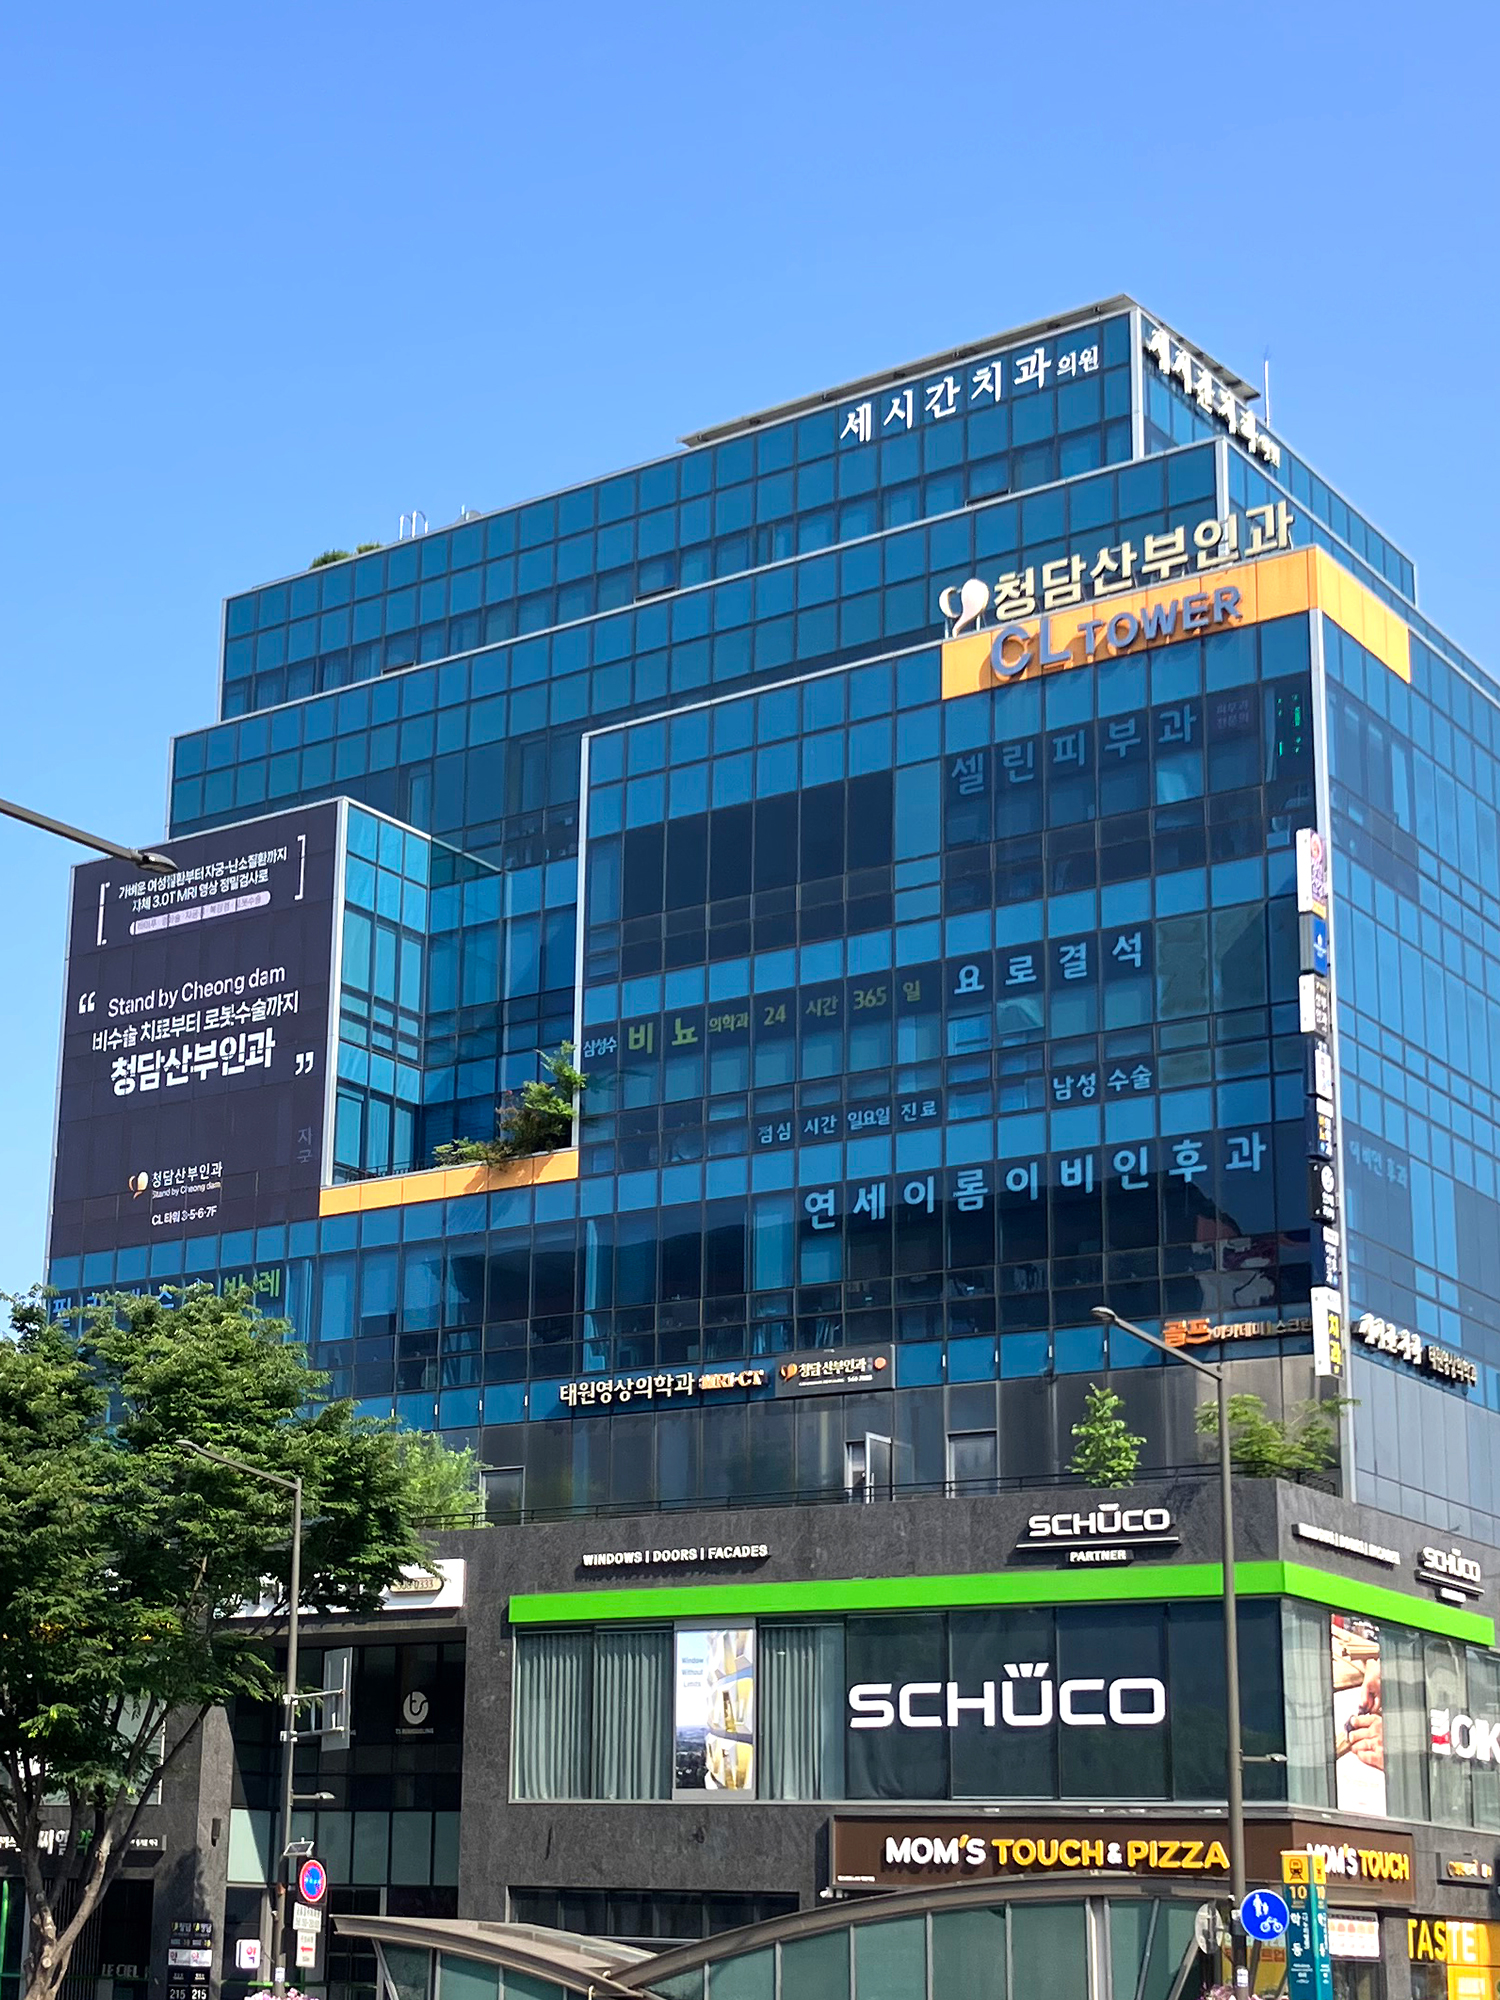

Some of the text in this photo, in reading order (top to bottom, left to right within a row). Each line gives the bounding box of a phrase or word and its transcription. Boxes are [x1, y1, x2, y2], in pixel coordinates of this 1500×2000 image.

[993, 500, 1294, 622] 청담산부인과
[990, 585, 1242, 677] CL TOWER
[177, 886, 197, 903] MRI
[199, 882, 219, 898] 영상
[953, 930, 1143, 996] 요로결석
[108, 966, 286, 1018] Stand by Cheong dam
[92, 990, 299, 1052] 비수술 치료부터 로봇수술까지
[110, 1027, 276, 1096] 청담산부인과
[1052, 1063, 1153, 1101] 남성 수술
[757, 1100, 938, 1145] 점심 시간 일요일 진료
[151, 1160, 223, 1188] 청담산부인과
[558, 1373, 694, 1407] 태원영상의학과
[1028, 1503, 1171, 1537] SCHÜCO
[583, 1544, 768, 1566] WINDOWS DOORS FACADES
[1069, 1549, 1127, 1563] PARTNER
[849, 1662, 1166, 1728] SCHÜCO
[885, 1834, 986, 1865] MOM'S
[991, 1838, 1104, 1867] TOUCH
[1127, 1841, 1230, 1869] PIZZA
[1358, 1849, 1409, 1880] TOUCH
[1289, 1885, 1307, 1900] 10
[1407, 1918, 1477, 1962] TASTE
[191, 1988, 207, 2000] 215
